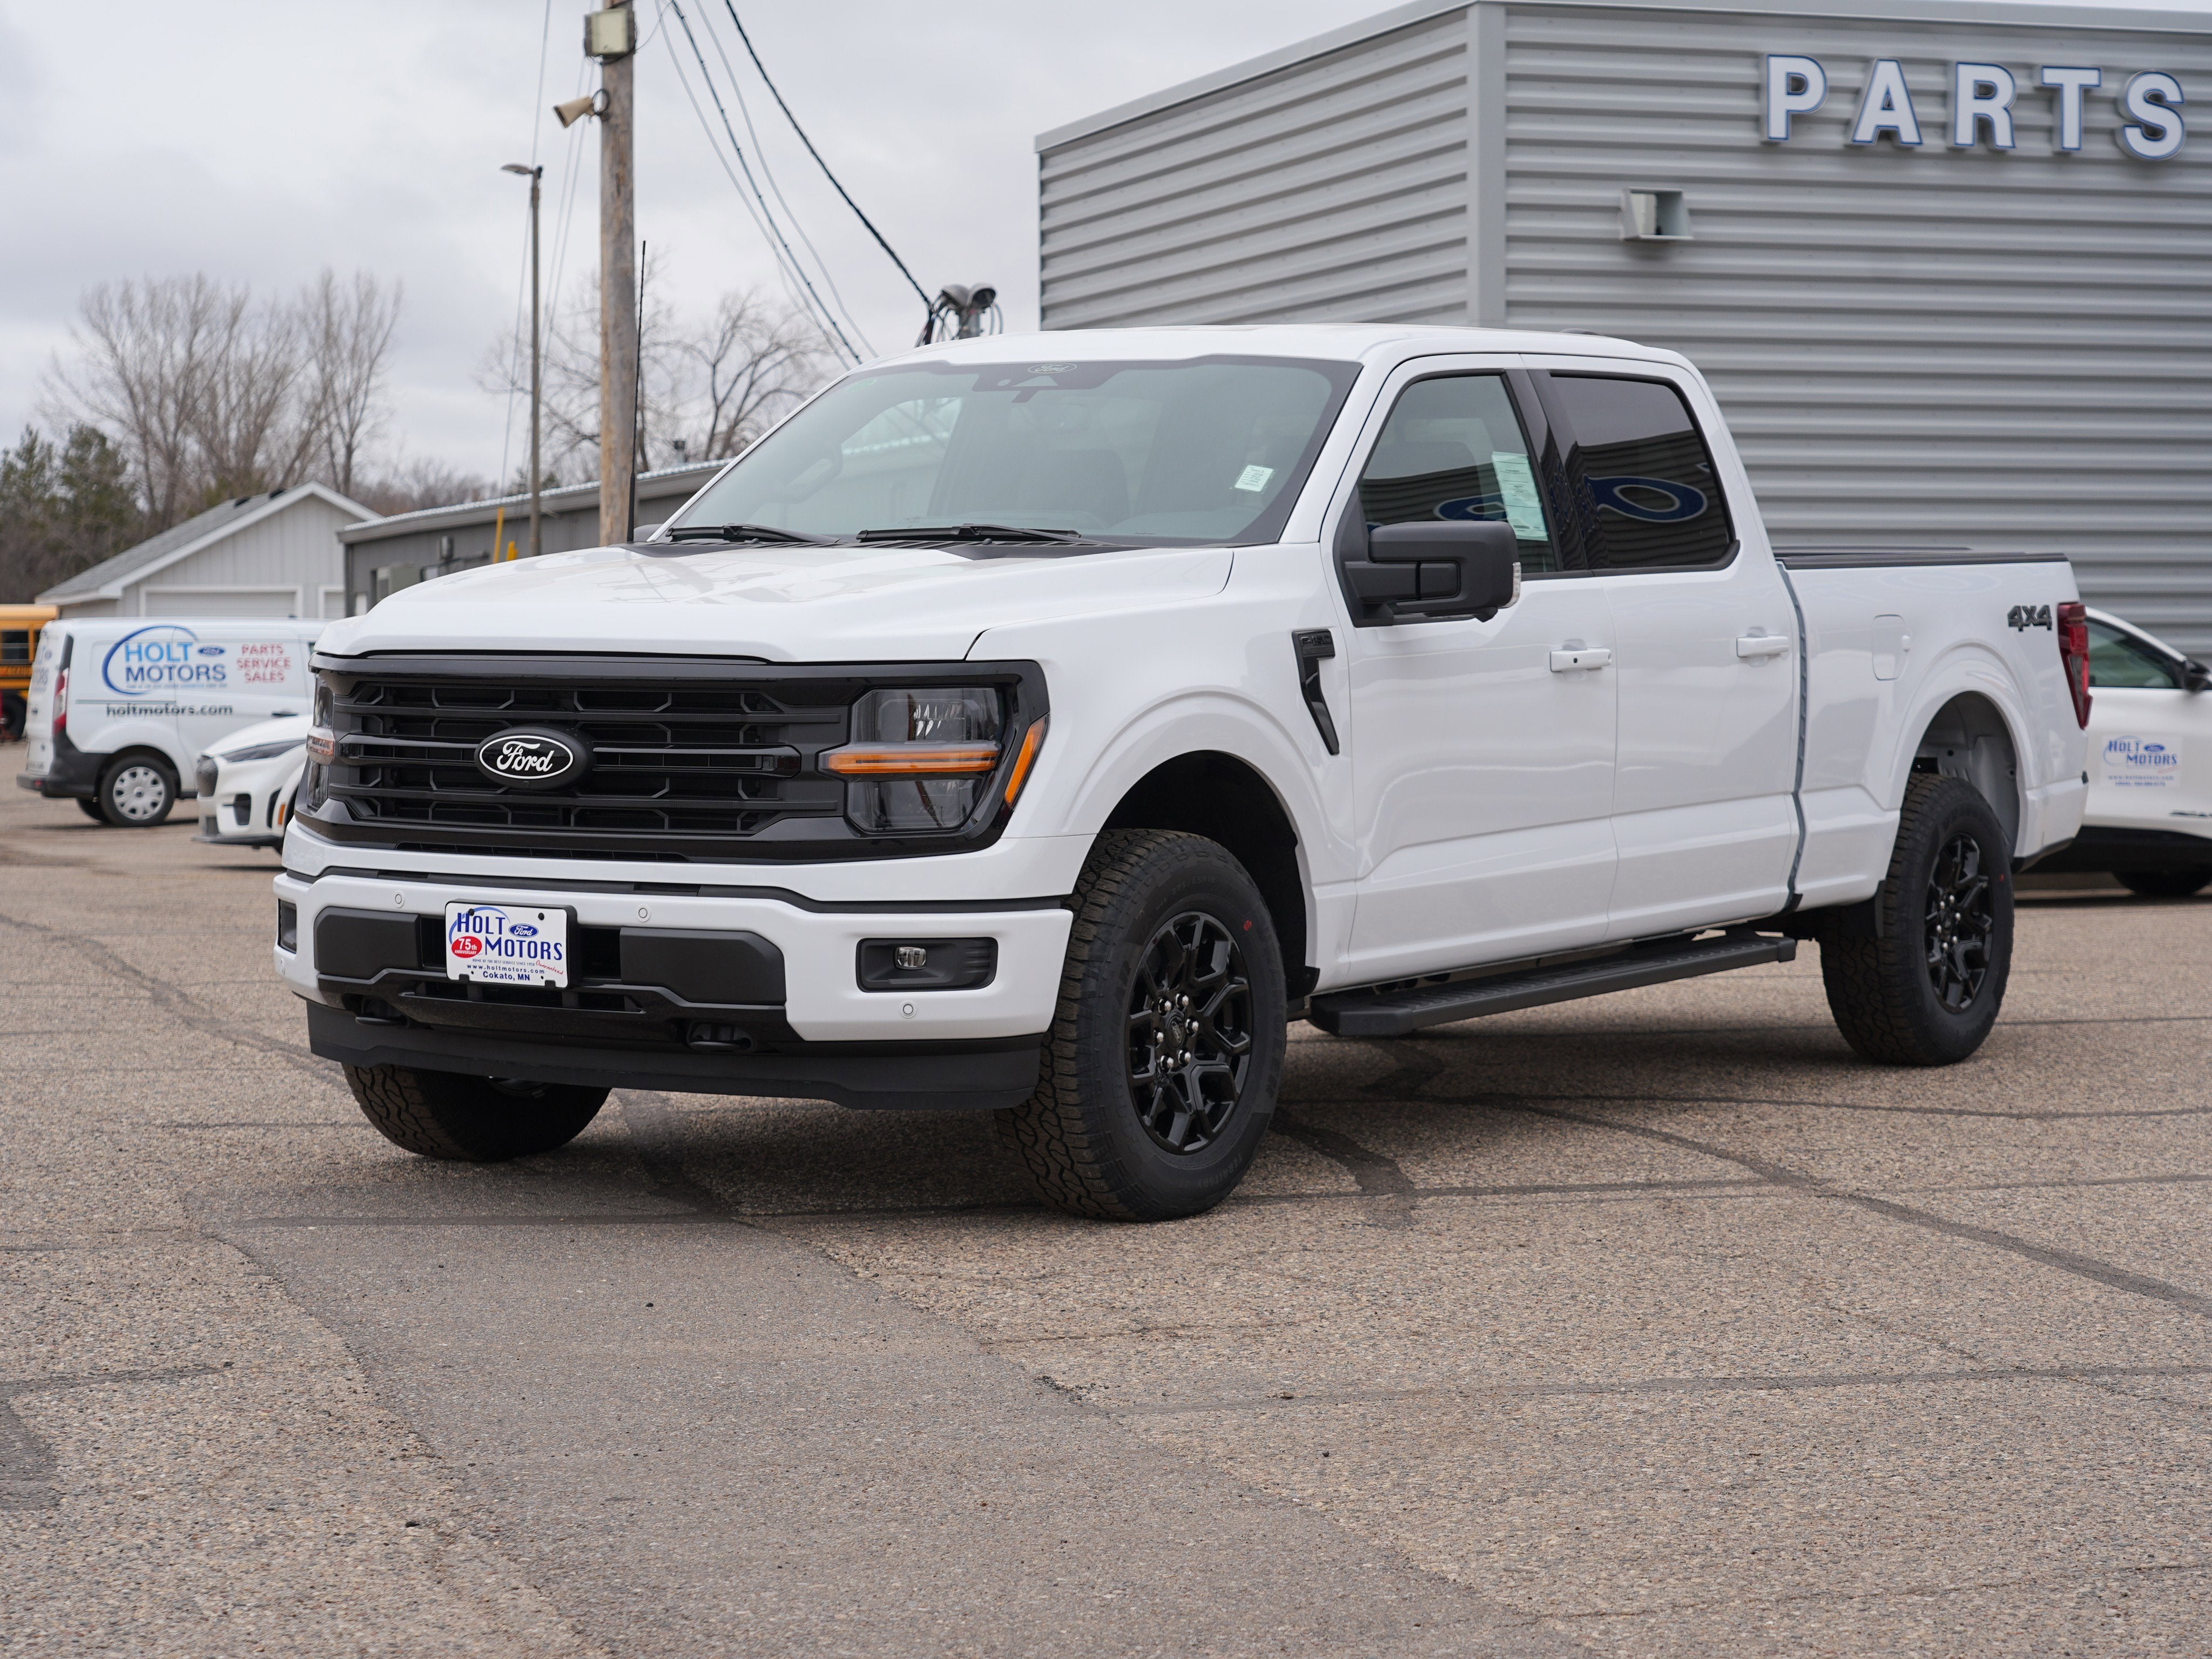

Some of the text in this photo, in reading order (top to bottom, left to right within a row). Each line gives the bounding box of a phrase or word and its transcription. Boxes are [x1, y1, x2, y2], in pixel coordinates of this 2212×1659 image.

[1763, 53, 2185, 160] PARTS
[1034, 364, 1070, 372] Ford
[125, 642, 193, 662] HOLT
[241, 643, 284, 655] PARTS
[237, 657, 291, 670] SERVICE
[125, 664, 226, 682] MOTORS
[245, 671, 285, 683] SALES
[106, 702, 233, 717] holtmotors.com
[2108, 740, 2141, 752] HOLT
[496, 740, 555, 772] Ford
[2126, 754, 2177, 765] MOTORS
[457, 913, 505, 935] HOLT
[514, 926, 534, 936] Ford
[458, 938, 477, 950] 75th
[485, 935, 563, 961] MOTORS
[467, 964, 545, 974] www.holtmotors.com
[536, 960, 564, 975] Guaranteed
[483, 971, 515, 981] Cokato,
